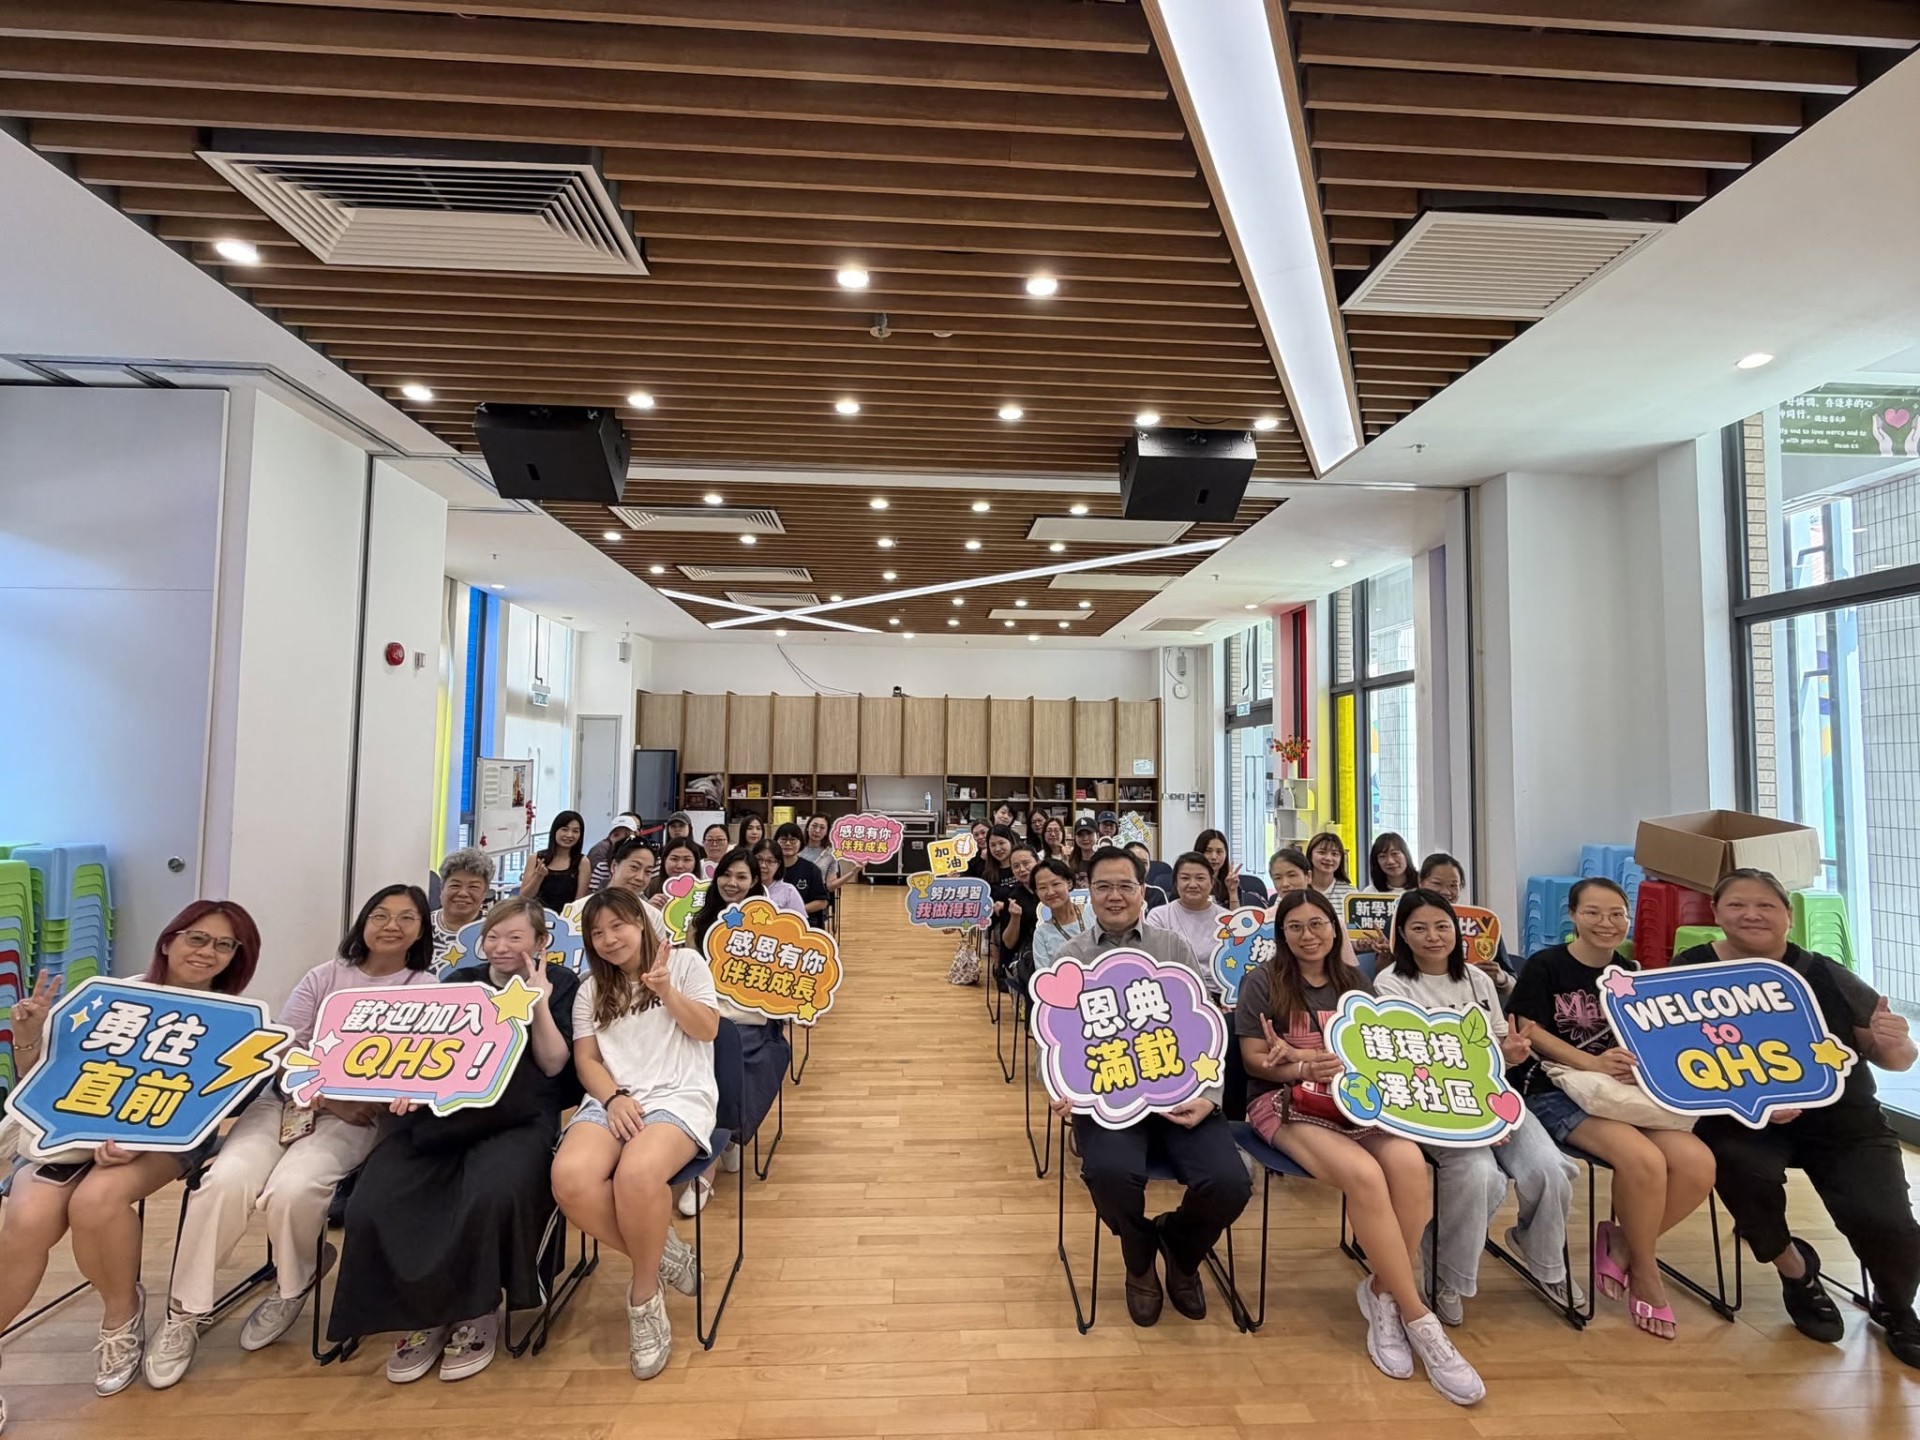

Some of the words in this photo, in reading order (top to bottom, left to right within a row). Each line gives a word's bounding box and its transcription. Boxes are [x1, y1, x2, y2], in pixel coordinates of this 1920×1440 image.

[838, 825, 892, 841] 感恩有你
[841, 840, 888, 853] 伴我成長
[916, 902, 980, 919] 我做得到
[931, 885, 982, 901] 努力學習
[726, 931, 828, 974] 感恩有你
[720, 960, 817, 1002] 伴我成長
[341, 1000, 483, 1034] 歡迎加入
[1078, 977, 1173, 1039] 恩典
[1624, 981, 1795, 1032] WELCOME
[82, 1001, 206, 1065] 勇往
[1360, 1024, 1468, 1070] 護環境
[1701, 1023, 1743, 1046] to
[1085, 1030, 1185, 1094] 滿載
[1677, 1040, 1804, 1091] QHS
[54, 1062, 193, 1128] 直前
[1377, 1071, 1484, 1116] 澤社區
